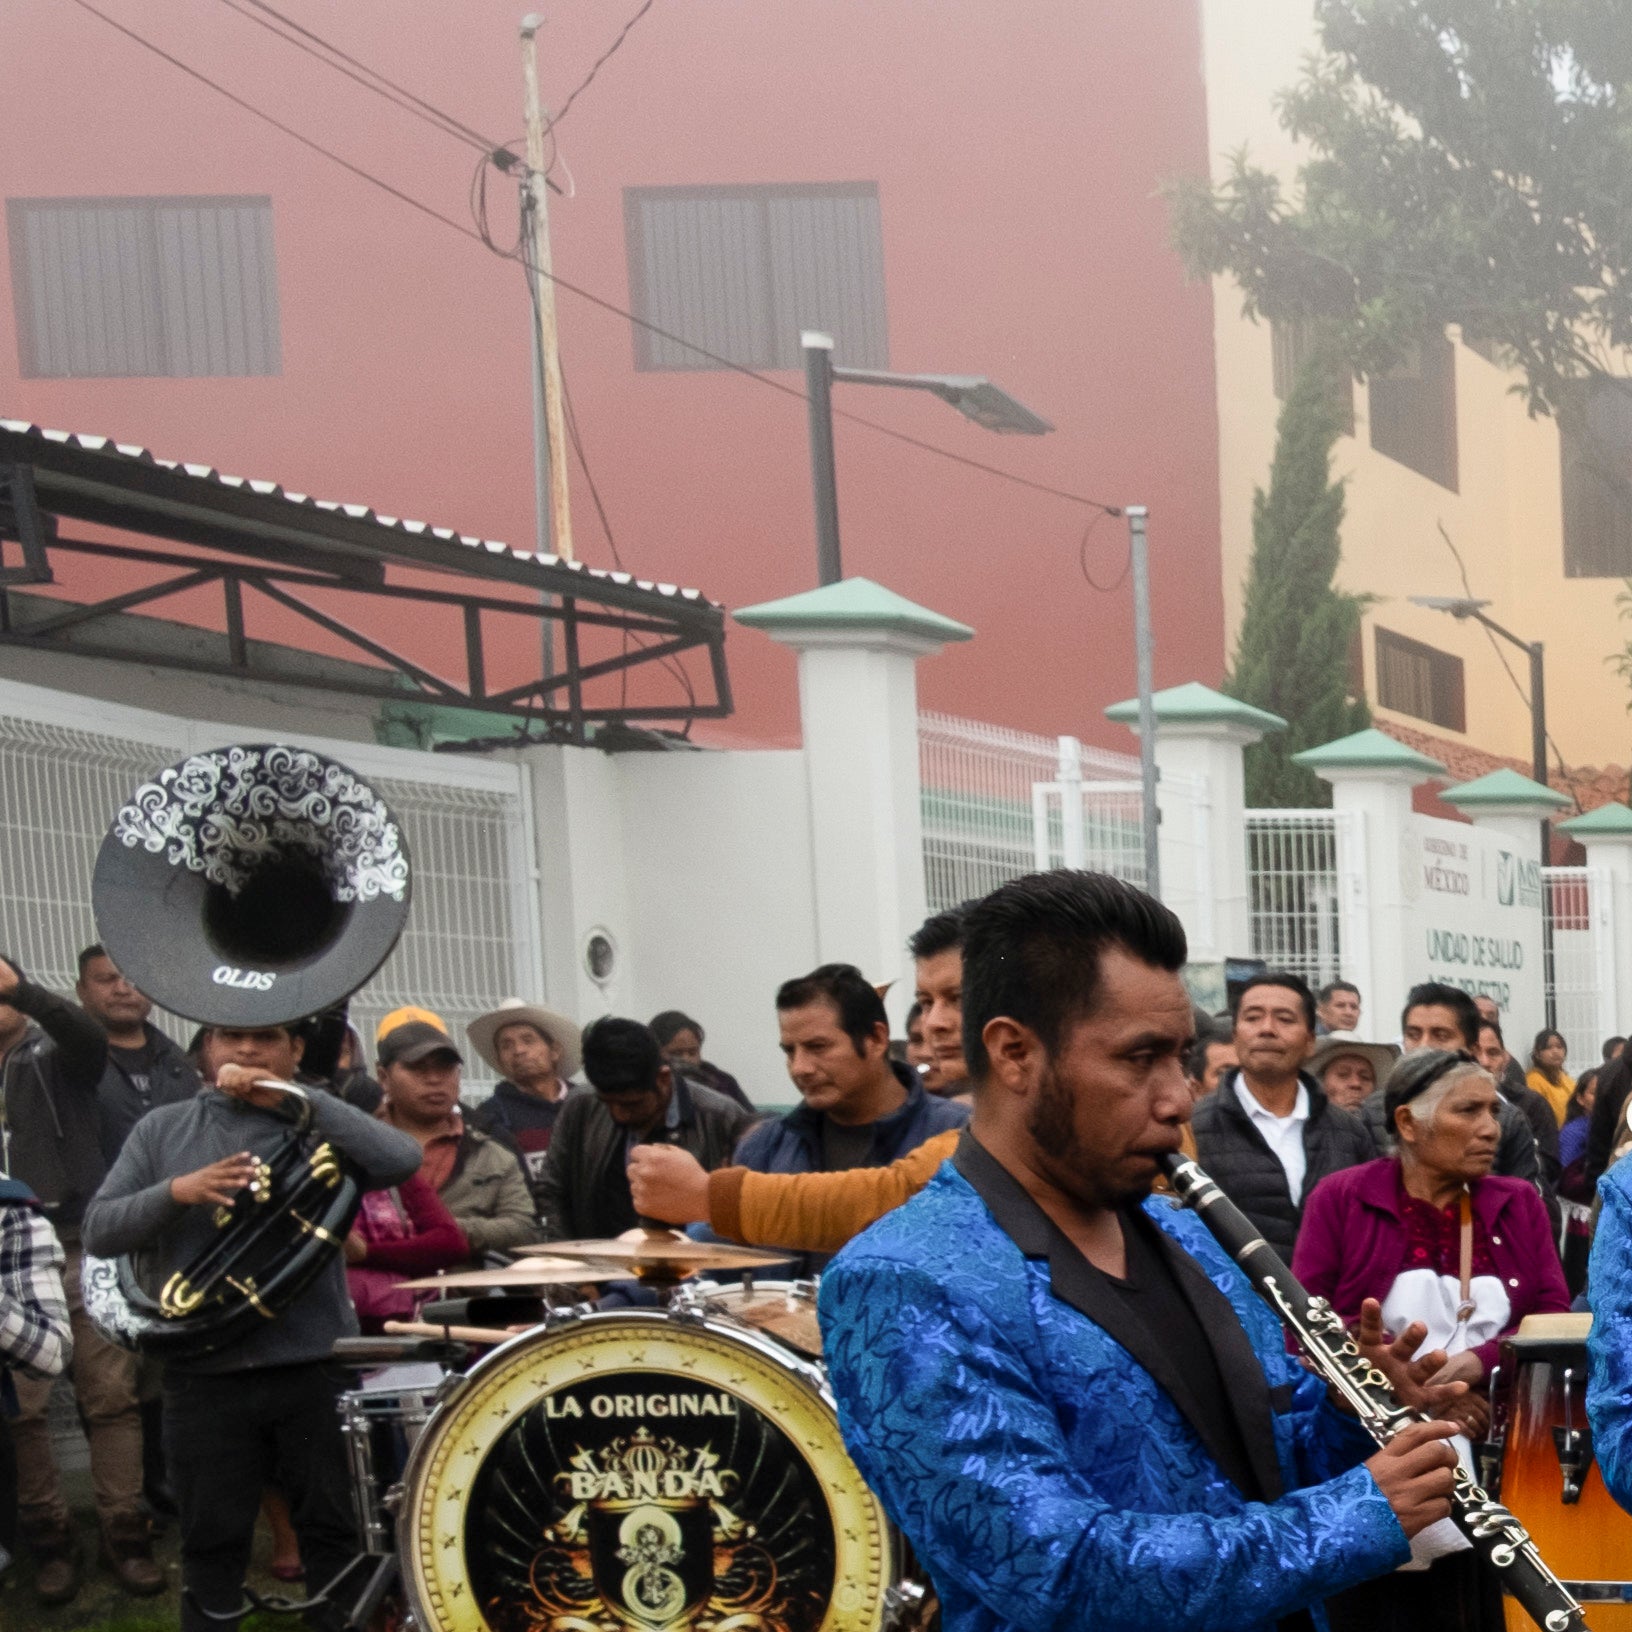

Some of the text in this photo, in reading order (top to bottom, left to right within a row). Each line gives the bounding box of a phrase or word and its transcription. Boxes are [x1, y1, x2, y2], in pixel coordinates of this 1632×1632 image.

[1426, 929, 1524, 971] UNIDAD DE SALUD
[213, 965, 277, 991] OLDS
[545, 1393, 737, 1419] LA ORIGINAL
[570, 1469, 725, 1500] BANDA
